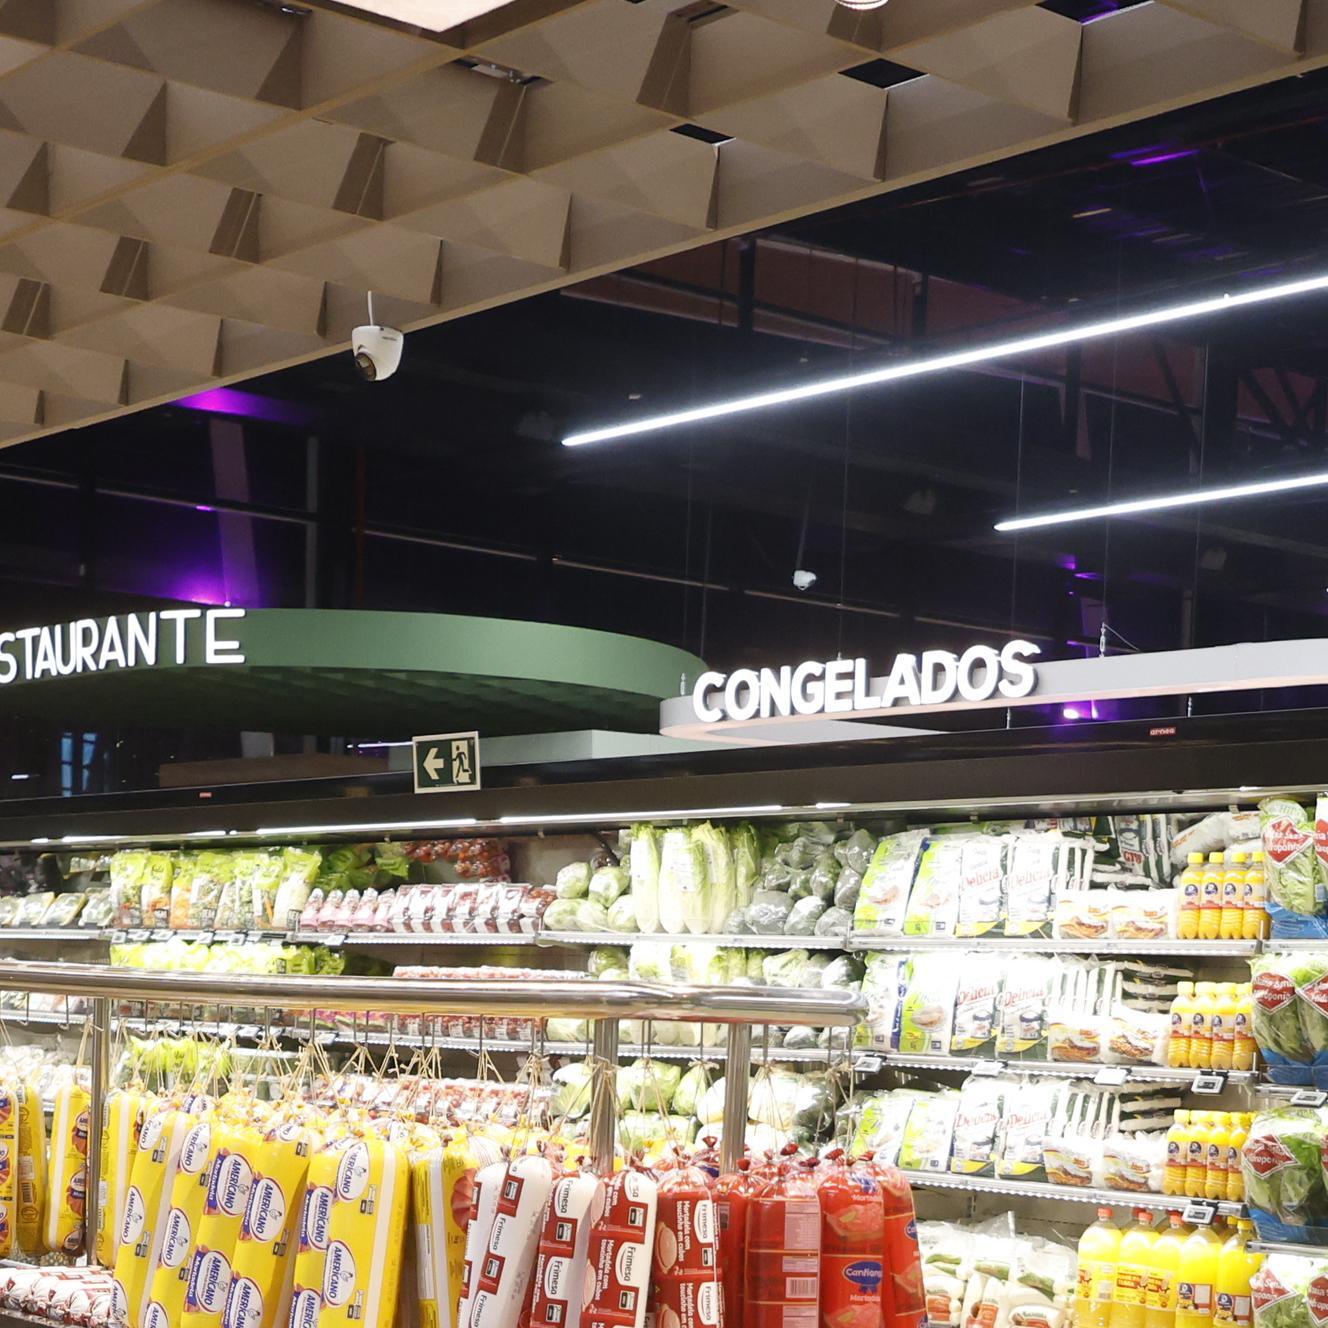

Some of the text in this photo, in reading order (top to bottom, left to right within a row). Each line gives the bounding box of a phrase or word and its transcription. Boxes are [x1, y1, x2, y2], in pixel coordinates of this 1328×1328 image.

[693, 638, 1042, 723] CONGELADOS
[226, 1160, 243, 1209] AMERICANO
[256, 1183, 274, 1234] AMERICANO
[165, 1213, 181, 1261] AMERICANO
[315, 1192, 330, 1243] AMERICANO
[493, 1217, 506, 1250] Frimesa
[205, 1256, 222, 1306] AMERICANO
[329, 1246, 342, 1299] AMERICANO
[551, 1260, 562, 1295] Frimesa
[623, 1246, 637, 1282] Frimesa
